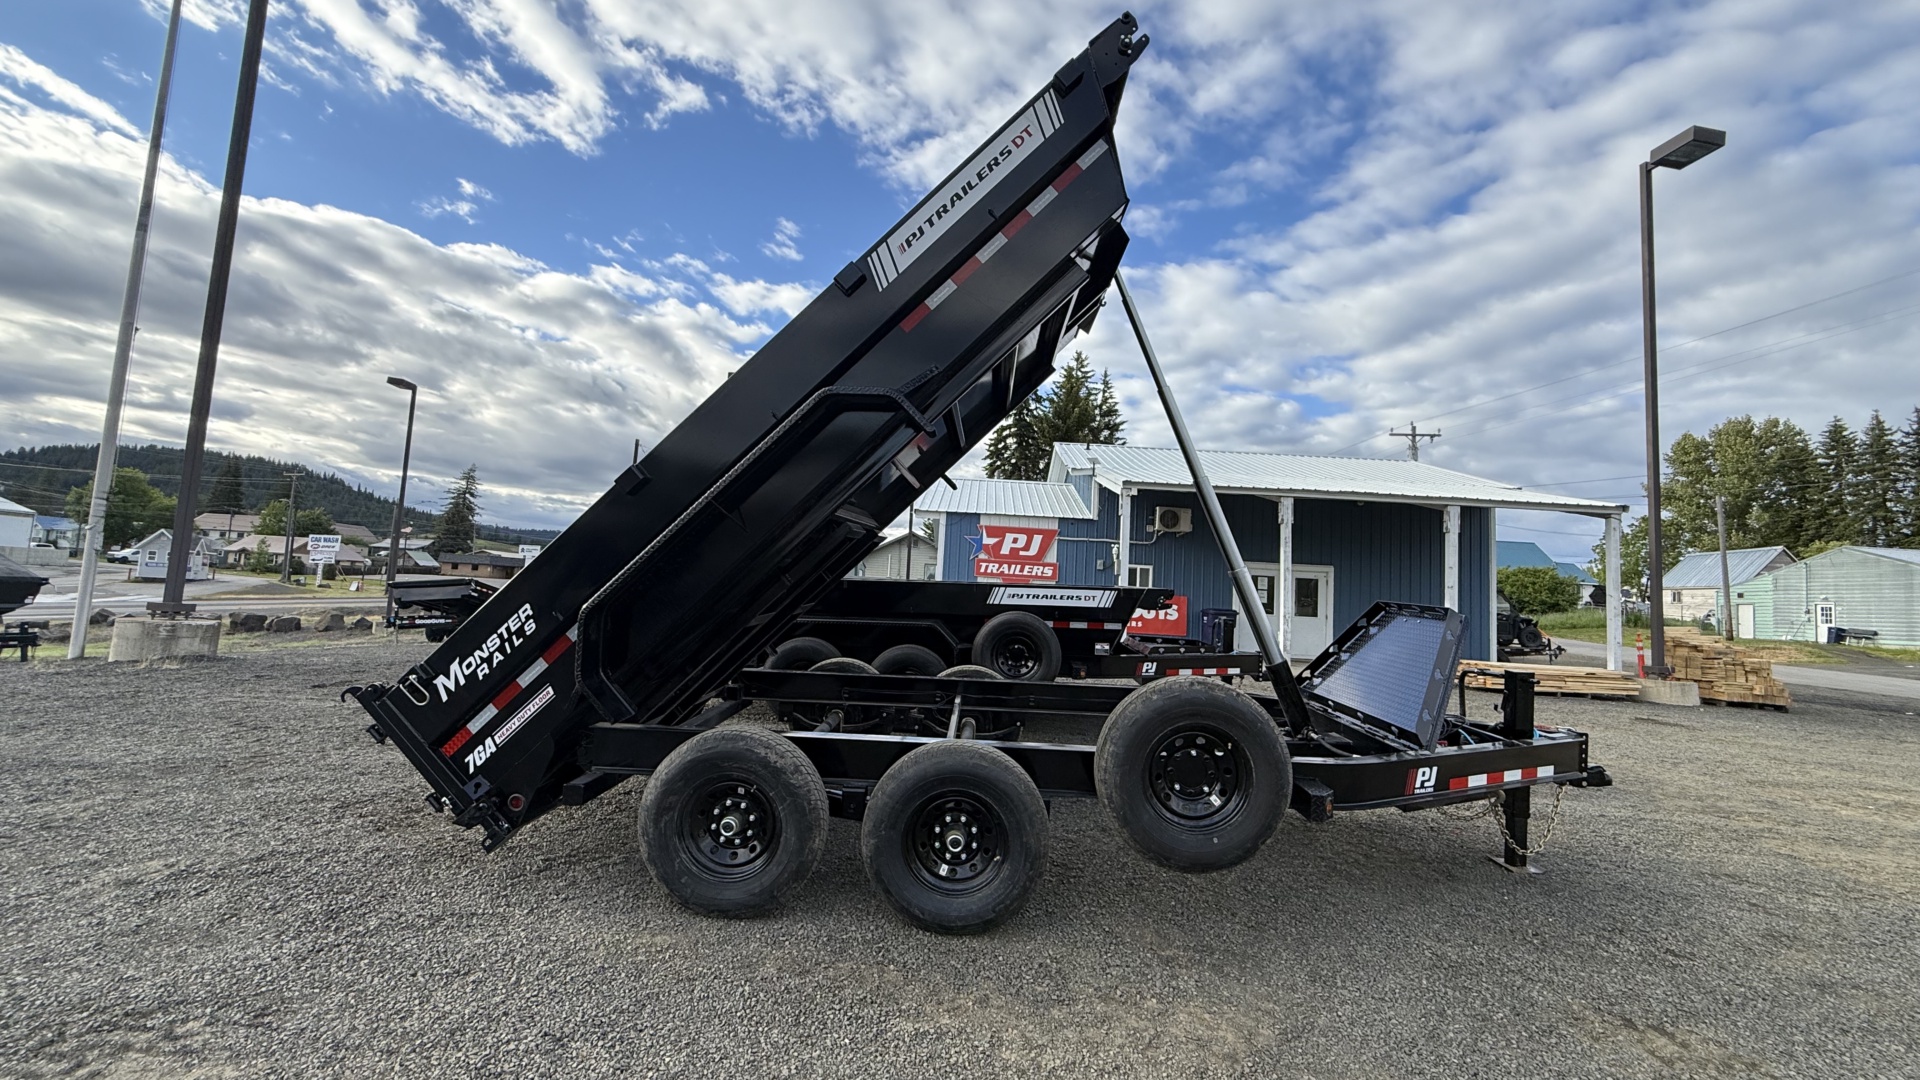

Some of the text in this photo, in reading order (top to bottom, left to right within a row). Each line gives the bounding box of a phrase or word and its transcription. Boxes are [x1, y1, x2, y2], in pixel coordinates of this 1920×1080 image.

[904, 124, 1034, 248] PJ TRAILERS DT
[1000, 533, 1043, 556] PJ
[979, 562, 1054, 577] TRAILERS
[1025, 593, 1083, 601] TRAILERS
[432, 603, 534, 703] MONSTER
[476, 619, 536, 681] RAILS
[1142, 661, 1158, 673] PJ
[464, 690, 551, 775] 7GA HEAVY DUTY FLOOR
[1414, 766, 1438, 788] PJ
